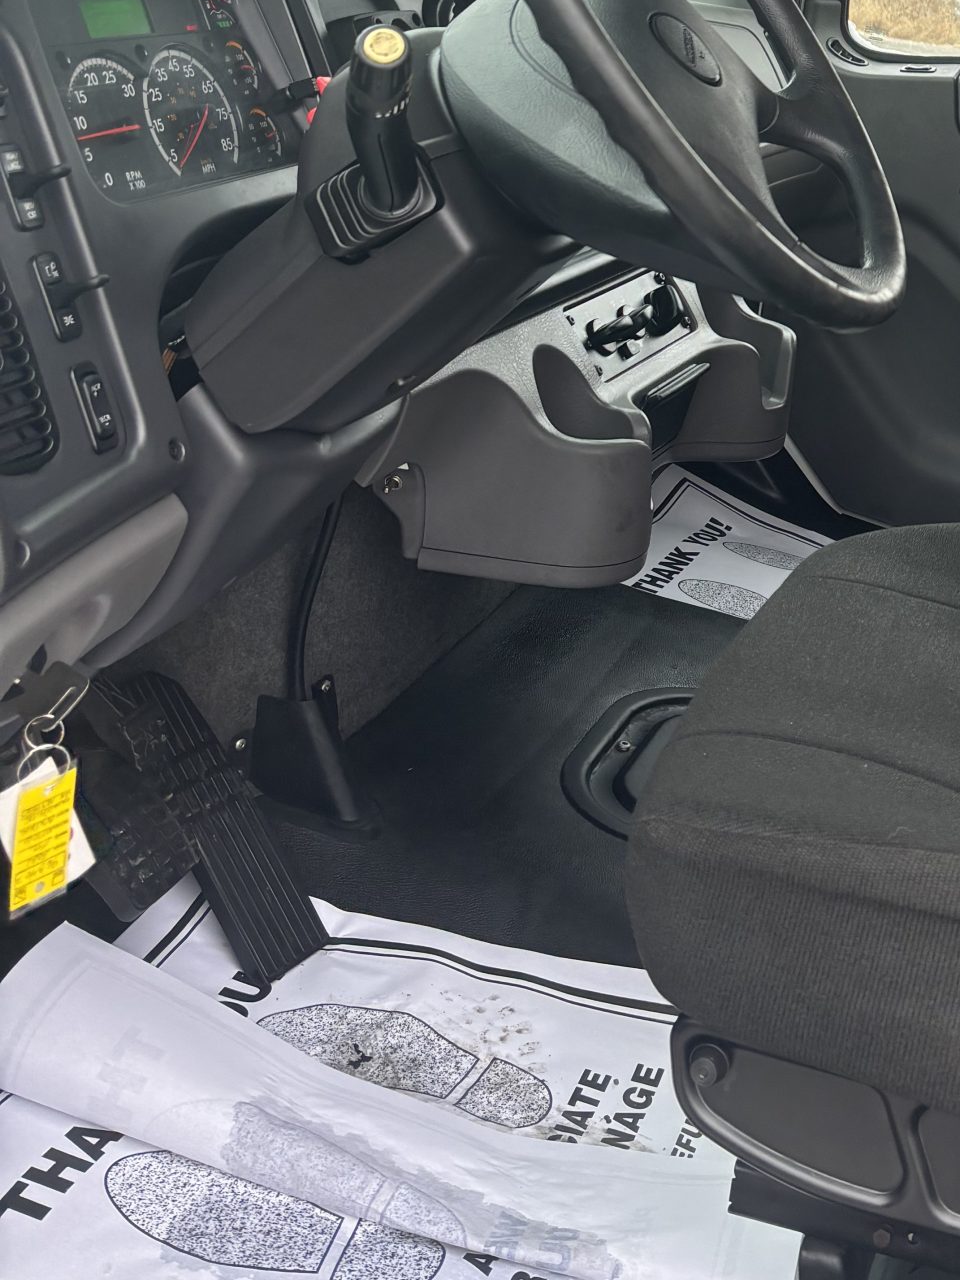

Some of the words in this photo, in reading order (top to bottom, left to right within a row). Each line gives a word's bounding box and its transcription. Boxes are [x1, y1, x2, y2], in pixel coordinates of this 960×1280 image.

[168, 59, 180, 72] 45
[183, 64, 195, 77] 55
[84, 72, 99, 86] 20
[102, 70, 117, 84] 25
[155, 68, 168, 82] 35
[122, 83, 136, 98] 30
[202, 80, 214, 94] 65
[74, 90, 88, 104] 15
[149, 87, 163, 102] 25
[216, 107, 228, 122] 75
[74, 115, 88, 130] 10
[153, 118, 165, 133] 15
[221, 137, 233, 151] 85
[85, 148, 94, 162] 5
[170, 149, 178, 162] 5
[202, 163, 217, 175] MPH
[104, 172, 114, 186] 0
[125, 171, 143, 182] RPM
[632, 546, 700, 594] THANK
[682, 517, 733, 547] YOU!
